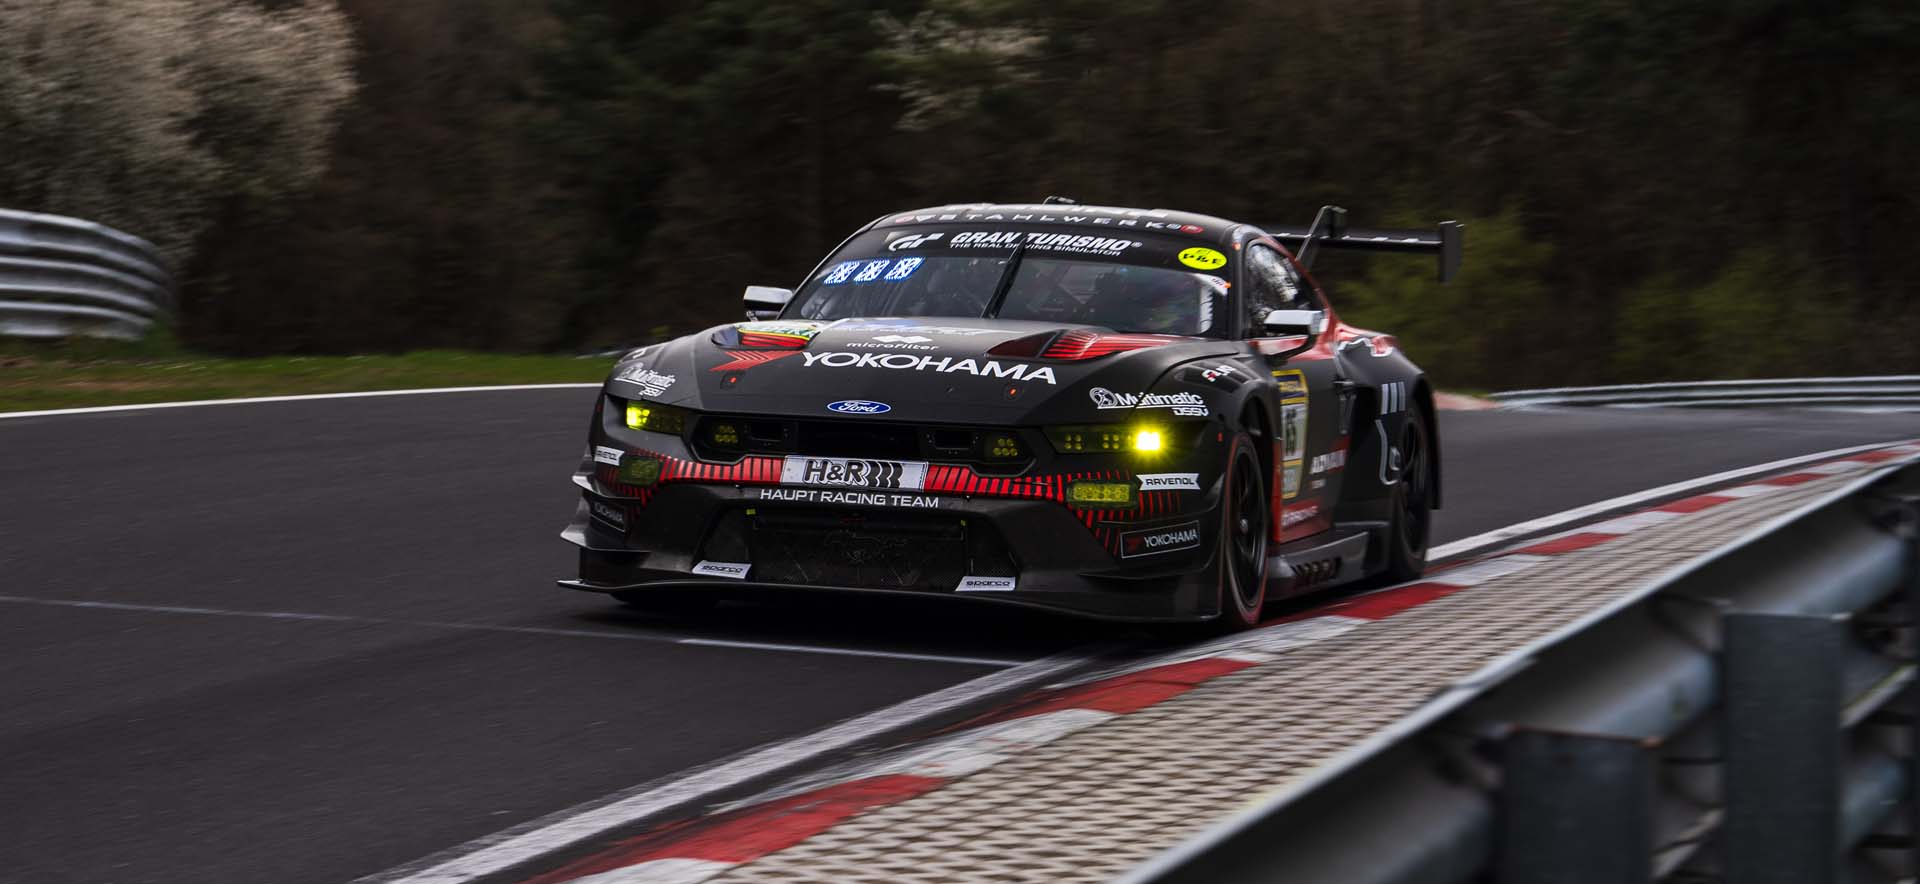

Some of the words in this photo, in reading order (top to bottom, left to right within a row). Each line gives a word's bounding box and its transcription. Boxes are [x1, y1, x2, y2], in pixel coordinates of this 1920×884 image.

[950, 231, 1022, 245] GRAN
[1052, 245, 1121, 257] SIMULATOR
[846, 342, 940, 351] microfilter
[801, 351, 1057, 385] YOKOHAMA
[1114, 391, 1205, 408] Multimatic
[838, 401, 879, 413] Ford
[802, 458, 871, 488] H&R
[1146, 476, 1195, 486] RAVENOL
[760, 489, 818, 502] HAUPT
[820, 491, 886, 506] RACING
[890, 495, 939, 509] TEAM
[1143, 528, 1199, 549] YOKOHAMA
[965, 579, 1011, 589] sparco
